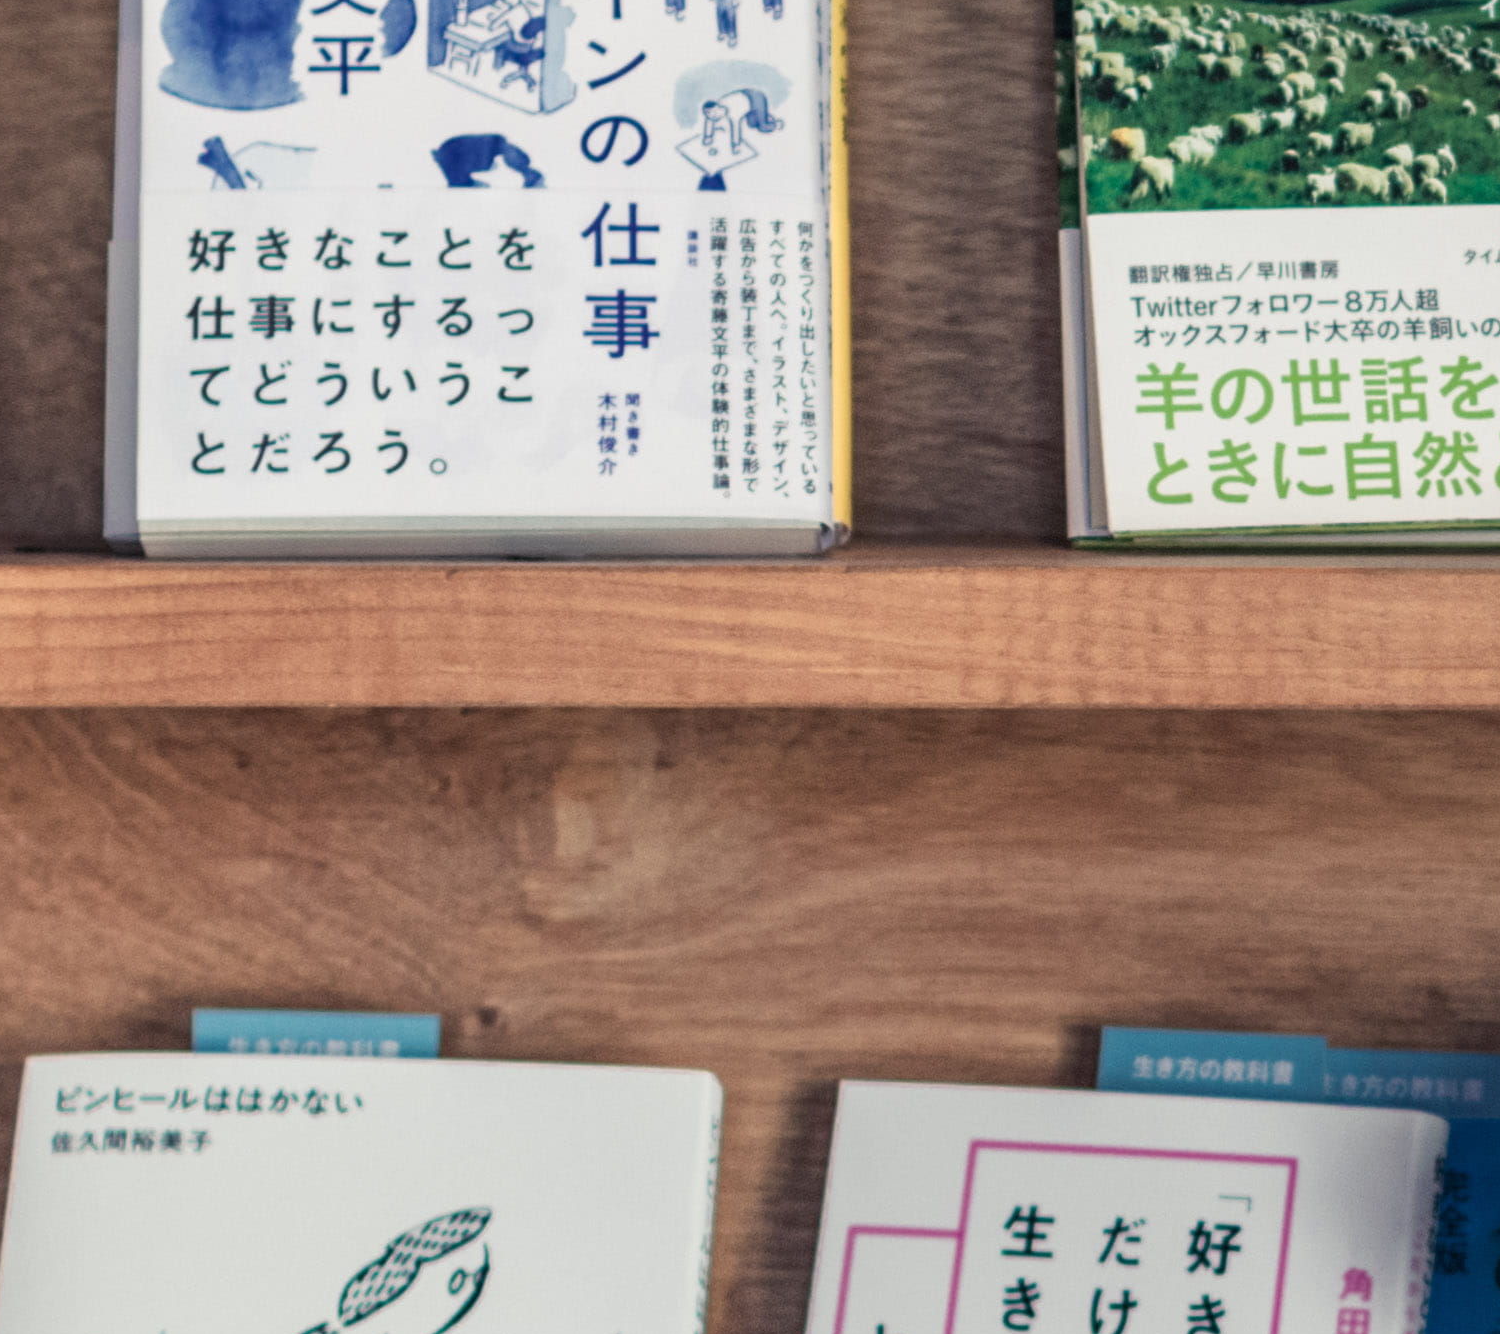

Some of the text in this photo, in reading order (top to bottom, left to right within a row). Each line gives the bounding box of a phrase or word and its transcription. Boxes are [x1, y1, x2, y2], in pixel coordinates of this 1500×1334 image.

[186, 225, 536, 273] 好きなことを
[1128, 259, 1340, 285] 翻訳権独占／早川書房
[185, 293, 536, 341] 仕事にするっ
[1129, 287, 1441, 320] Twitterフォロワー8万人超
[709, 216, 732, 499] 活躍する寄藤文平の体験的仕事論。
[739, 218, 760, 494] 広告から装丁まで、さまざまな形で
[768, 219, 790, 499] すべての人へ。イラスト、デザイン、
[797, 220, 818, 496] 何かをつくり出したいと思っている
[189, 361, 535, 409] てどういうこ
[597, 393, 618, 476] 木村俊介
[625, 393, 641, 457] 聞き書き
[190, 428, 449, 476] とだろう。
[1132, 1054, 1295, 1087] 生き方の教科書
[53, 1084, 365, 1116] ピンヒールははかない
[50, 1128, 213, 1156] 佐久間裕美子
